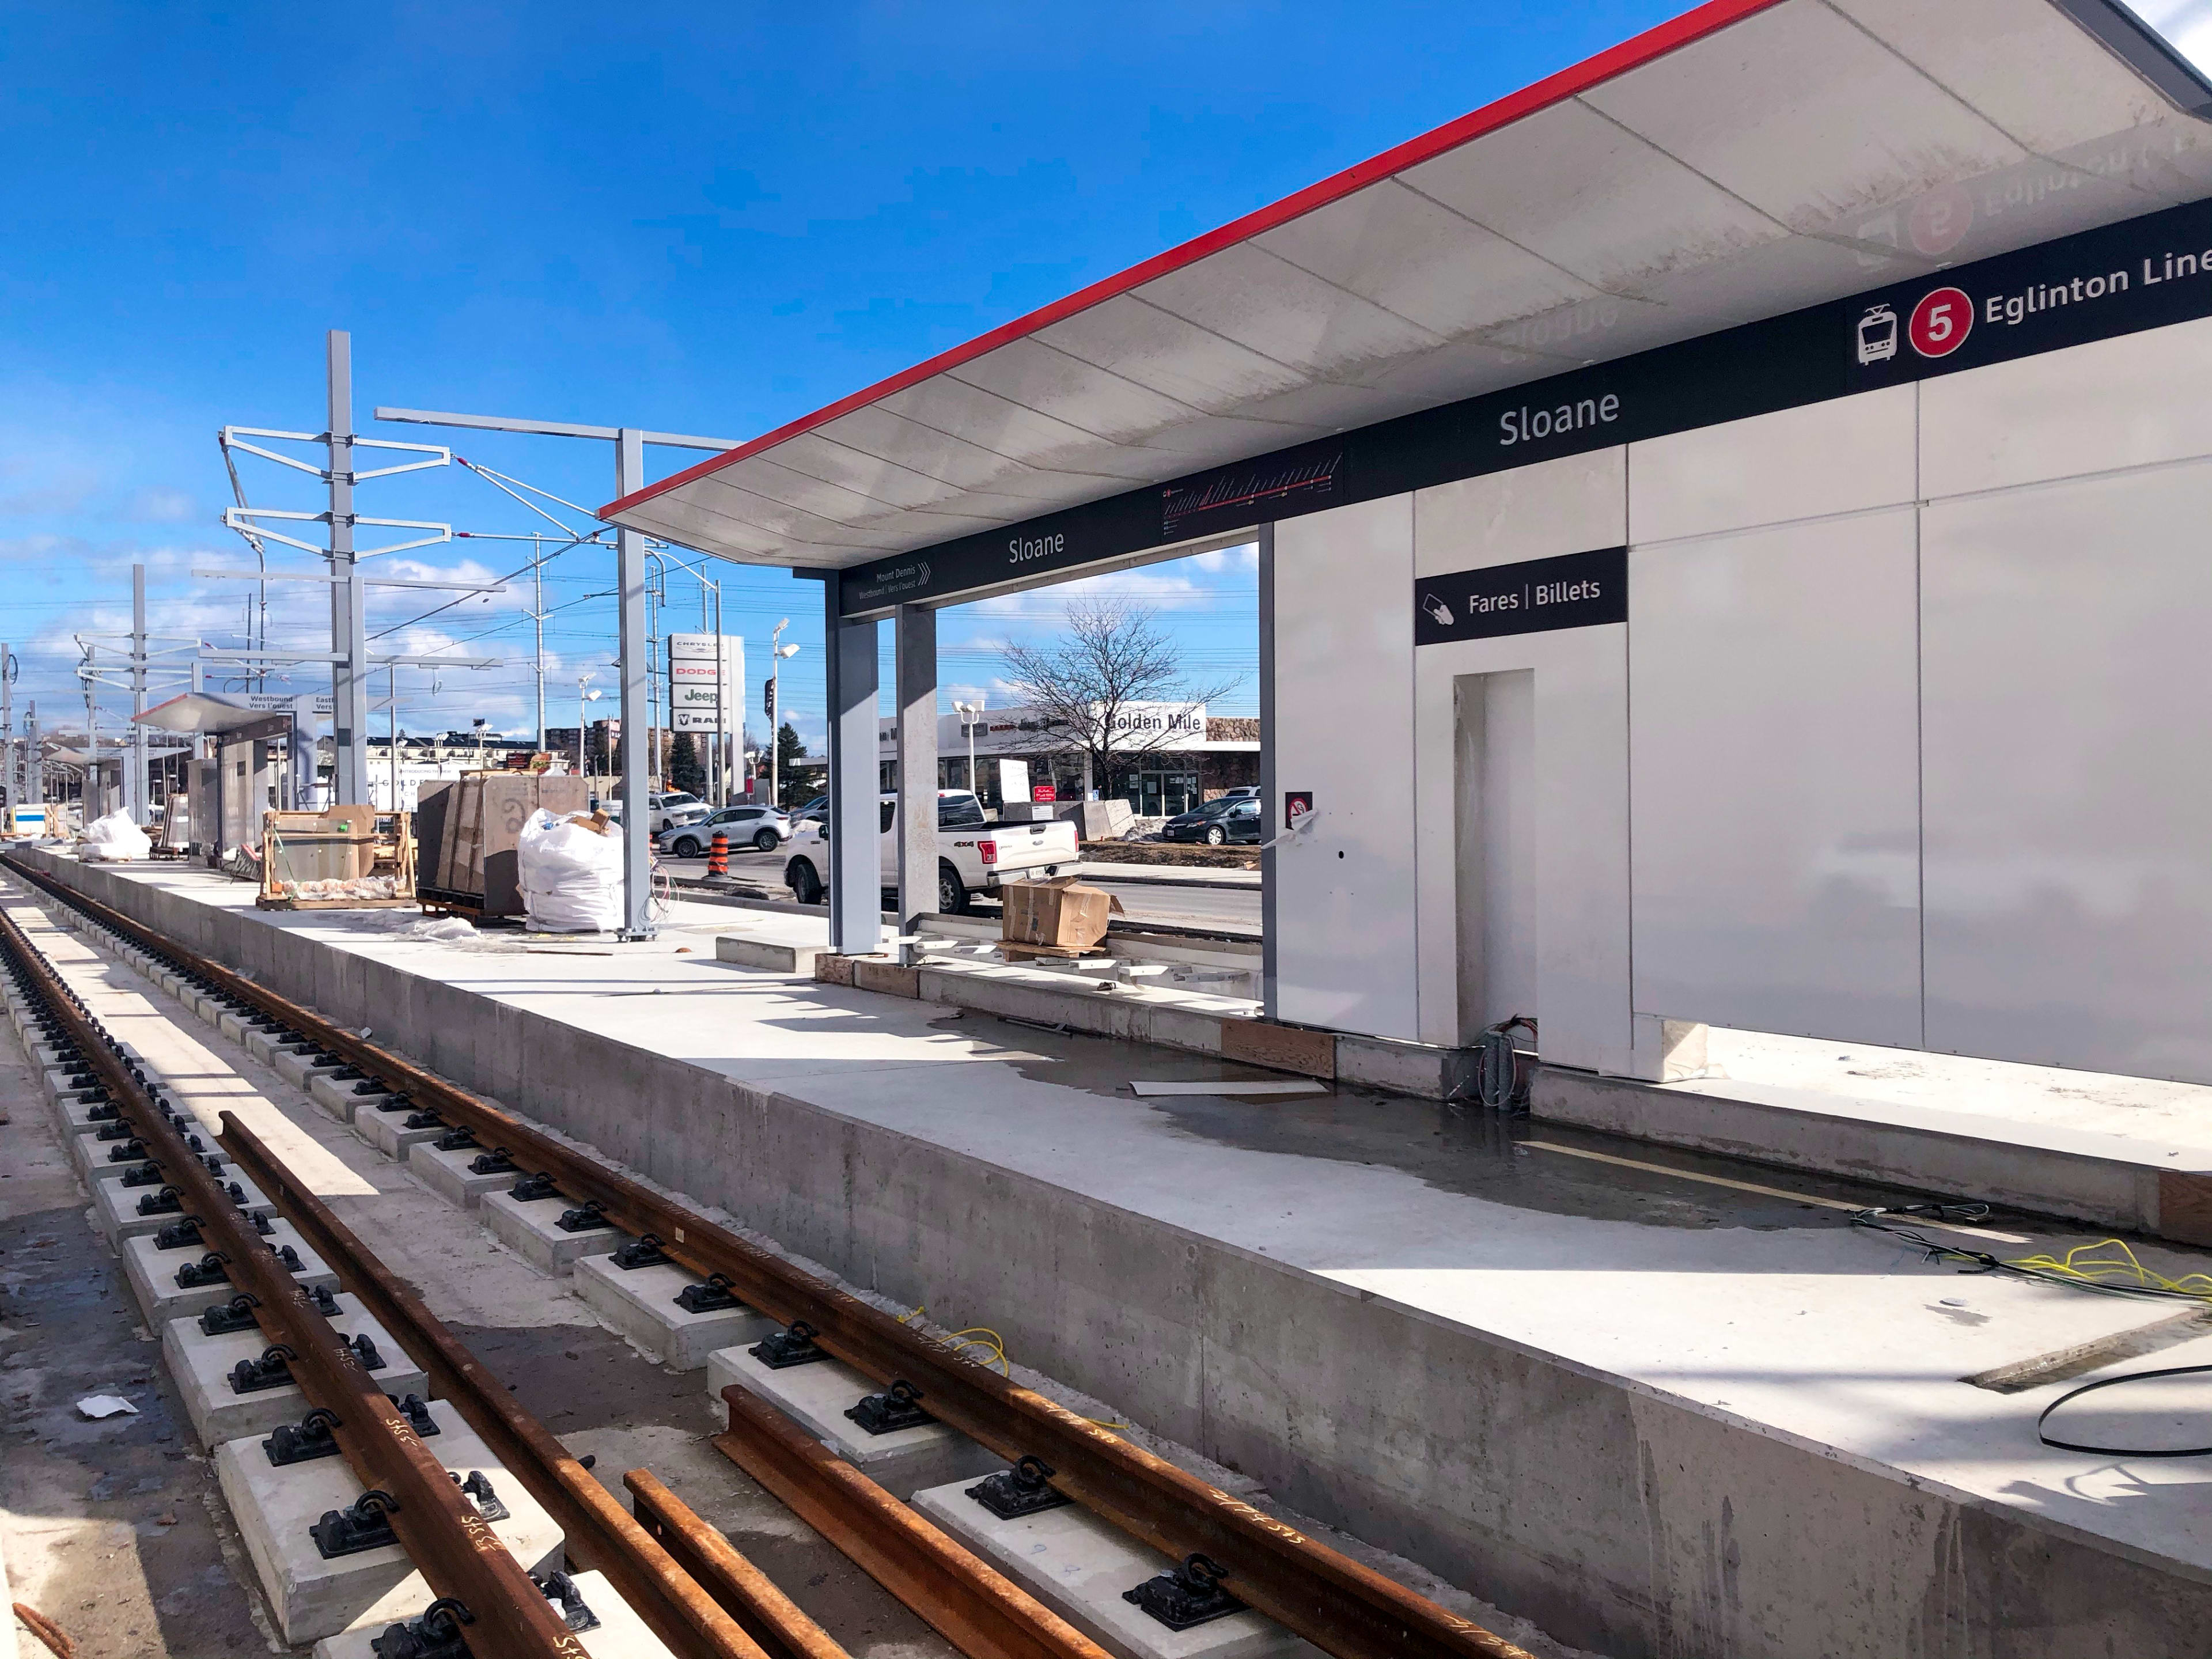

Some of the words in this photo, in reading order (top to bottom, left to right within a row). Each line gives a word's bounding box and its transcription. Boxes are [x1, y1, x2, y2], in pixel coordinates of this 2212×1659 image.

[1928, 304, 1953, 342] 5
[1986, 270, 2129, 325] Eglinton
[2144, 248, 2212, 285] Line
[1499, 394, 1619, 445] Sloane
[1009, 533, 1064, 563] Sloane
[877, 570, 895, 583] Mount
[896, 565, 916, 578] Dennis
[859, 585, 885, 600] Westbound
[888, 584, 899, 593] Vers
[899, 580, 916, 591] l'ouest
[1469, 593, 1518, 613] Fares
[1536, 579, 1601, 605] Billets
[684, 689, 718, 703] Jeep
[1168, 714, 1200, 730] Mile
